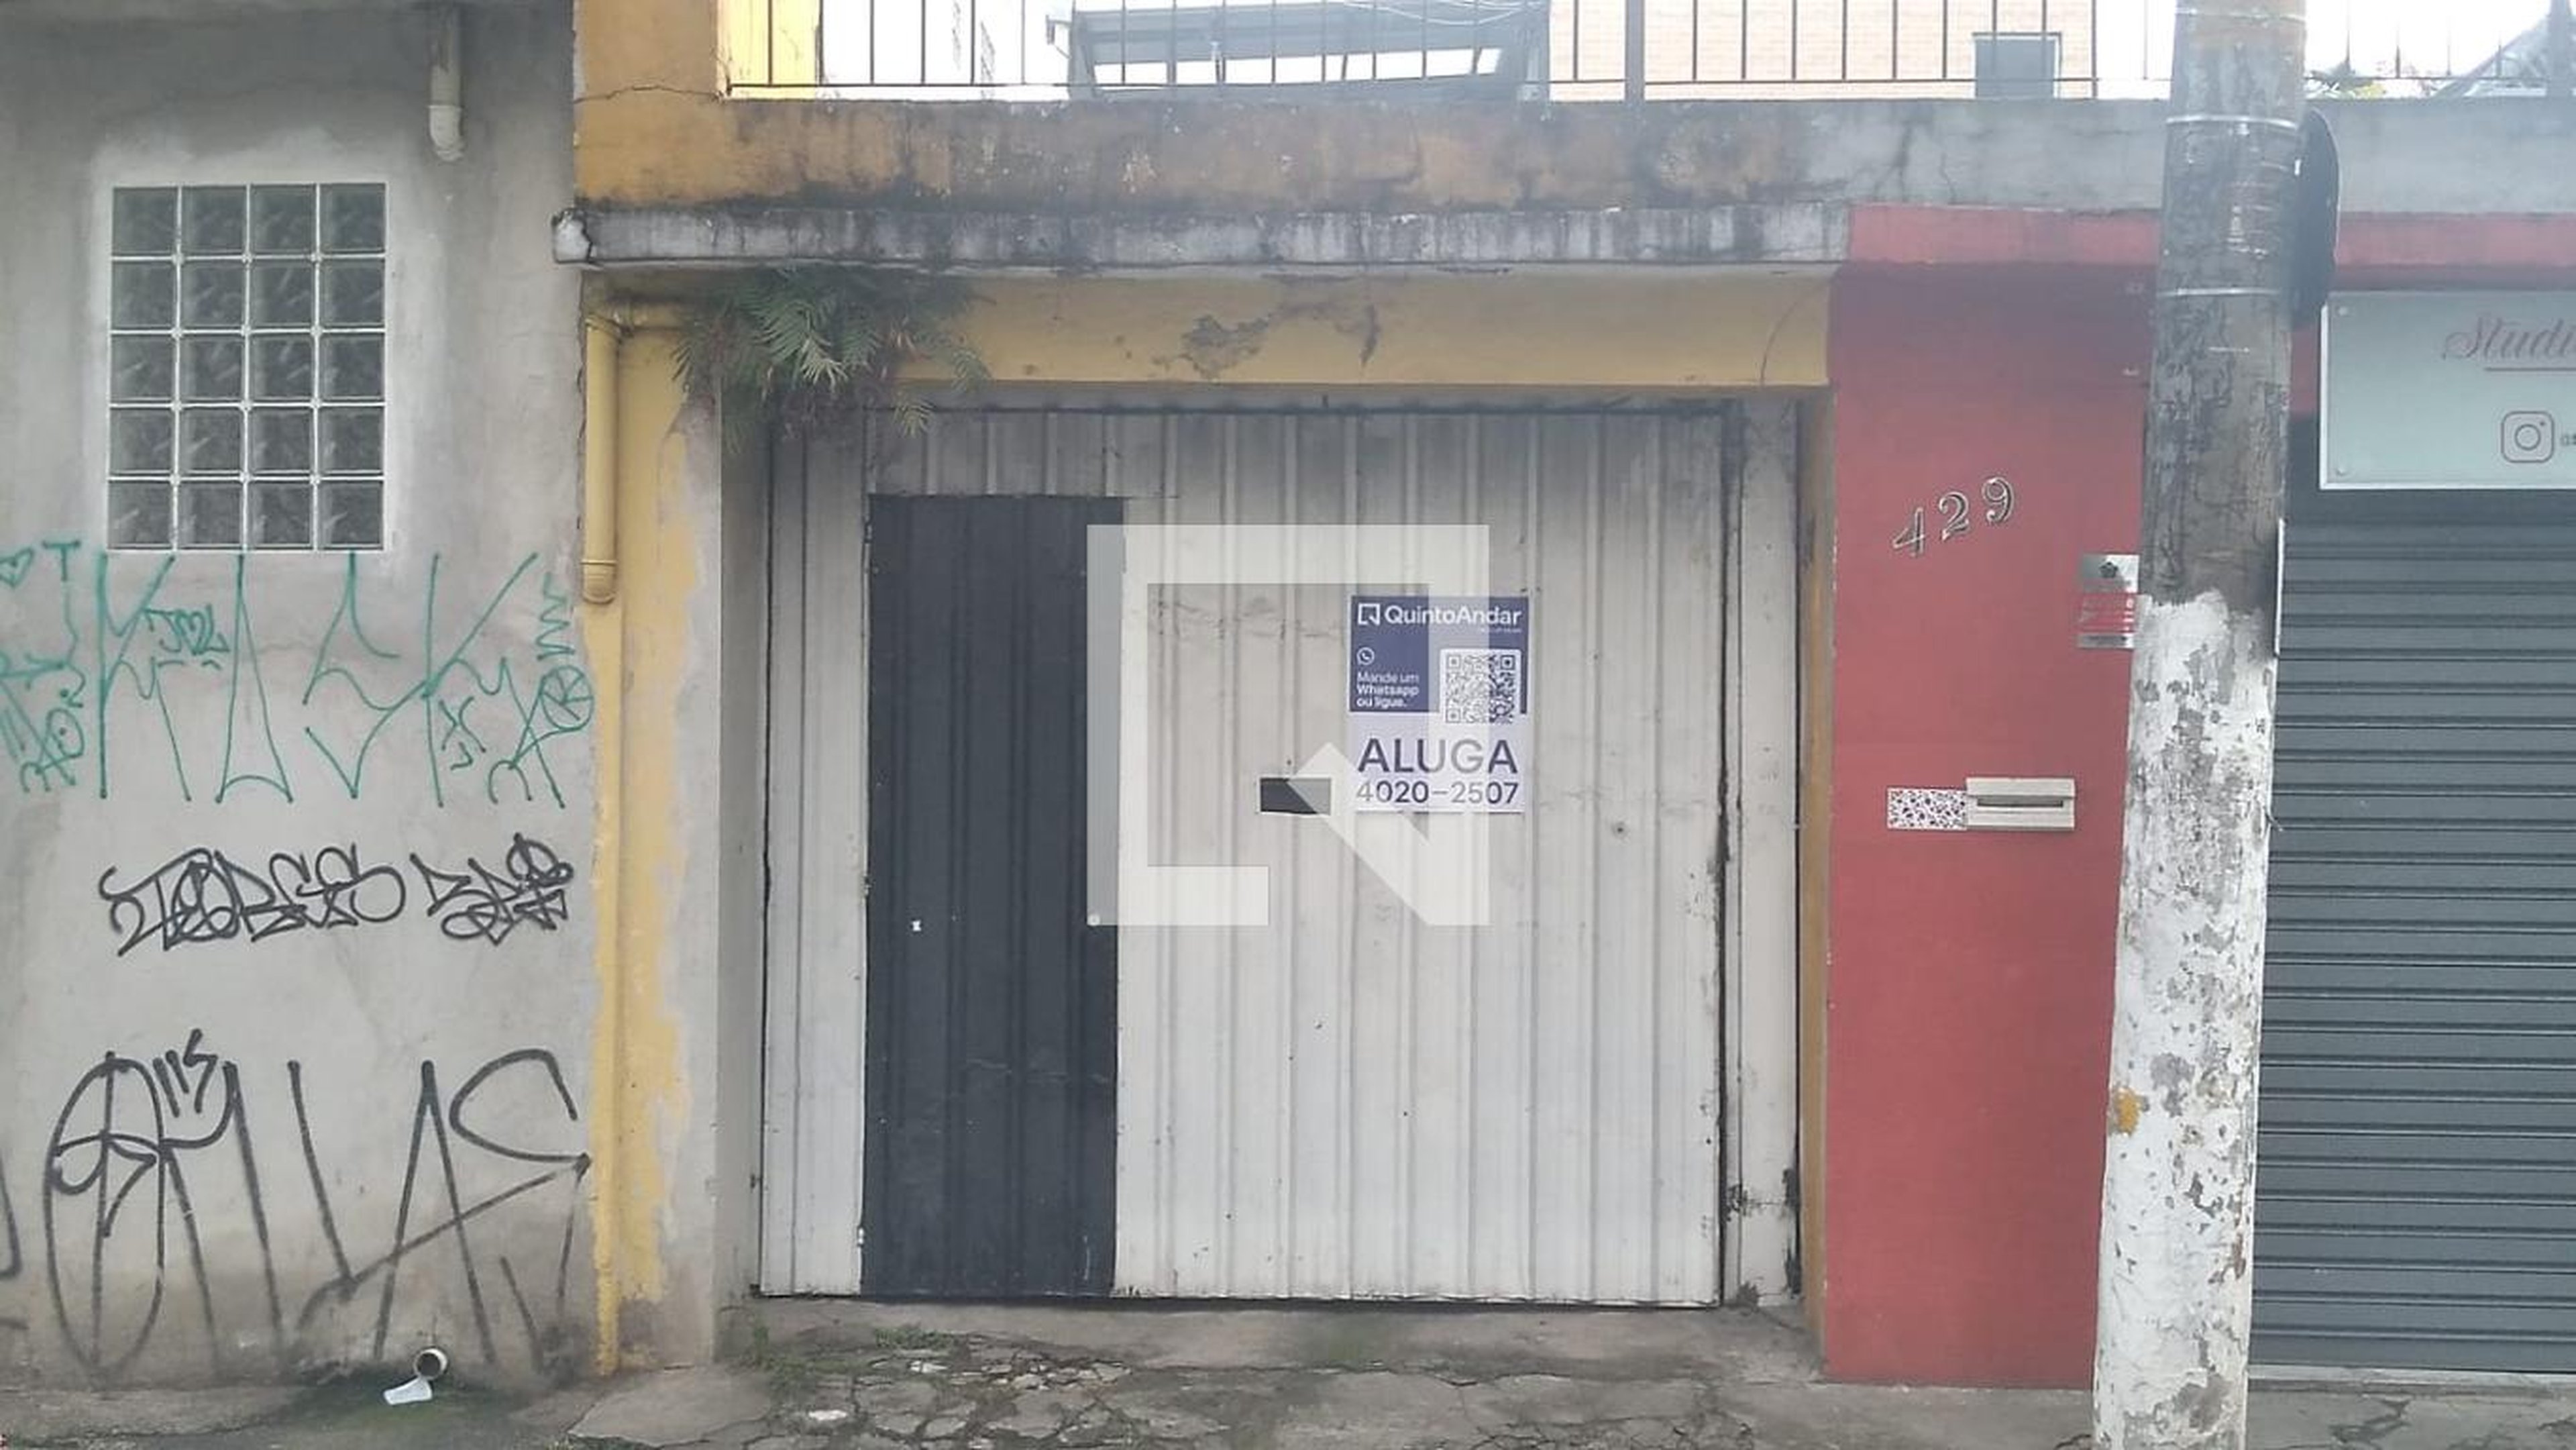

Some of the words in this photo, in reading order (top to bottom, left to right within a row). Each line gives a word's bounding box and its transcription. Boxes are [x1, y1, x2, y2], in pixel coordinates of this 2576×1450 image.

[2441, 317, 2576, 361] Studi
[1892, 476, 2014, 557] 429
[1385, 605, 1522, 625] QuintoAndar
[1356, 672, 1398, 683] Mande
[1400, 674, 1419, 683] um
[1356, 684, 1419, 697] Whatsapp
[1356, 698, 1373, 707] ou
[1358, 739, 1517, 773] ALUGA
[1356, 780, 1519, 804] 4020-2507
